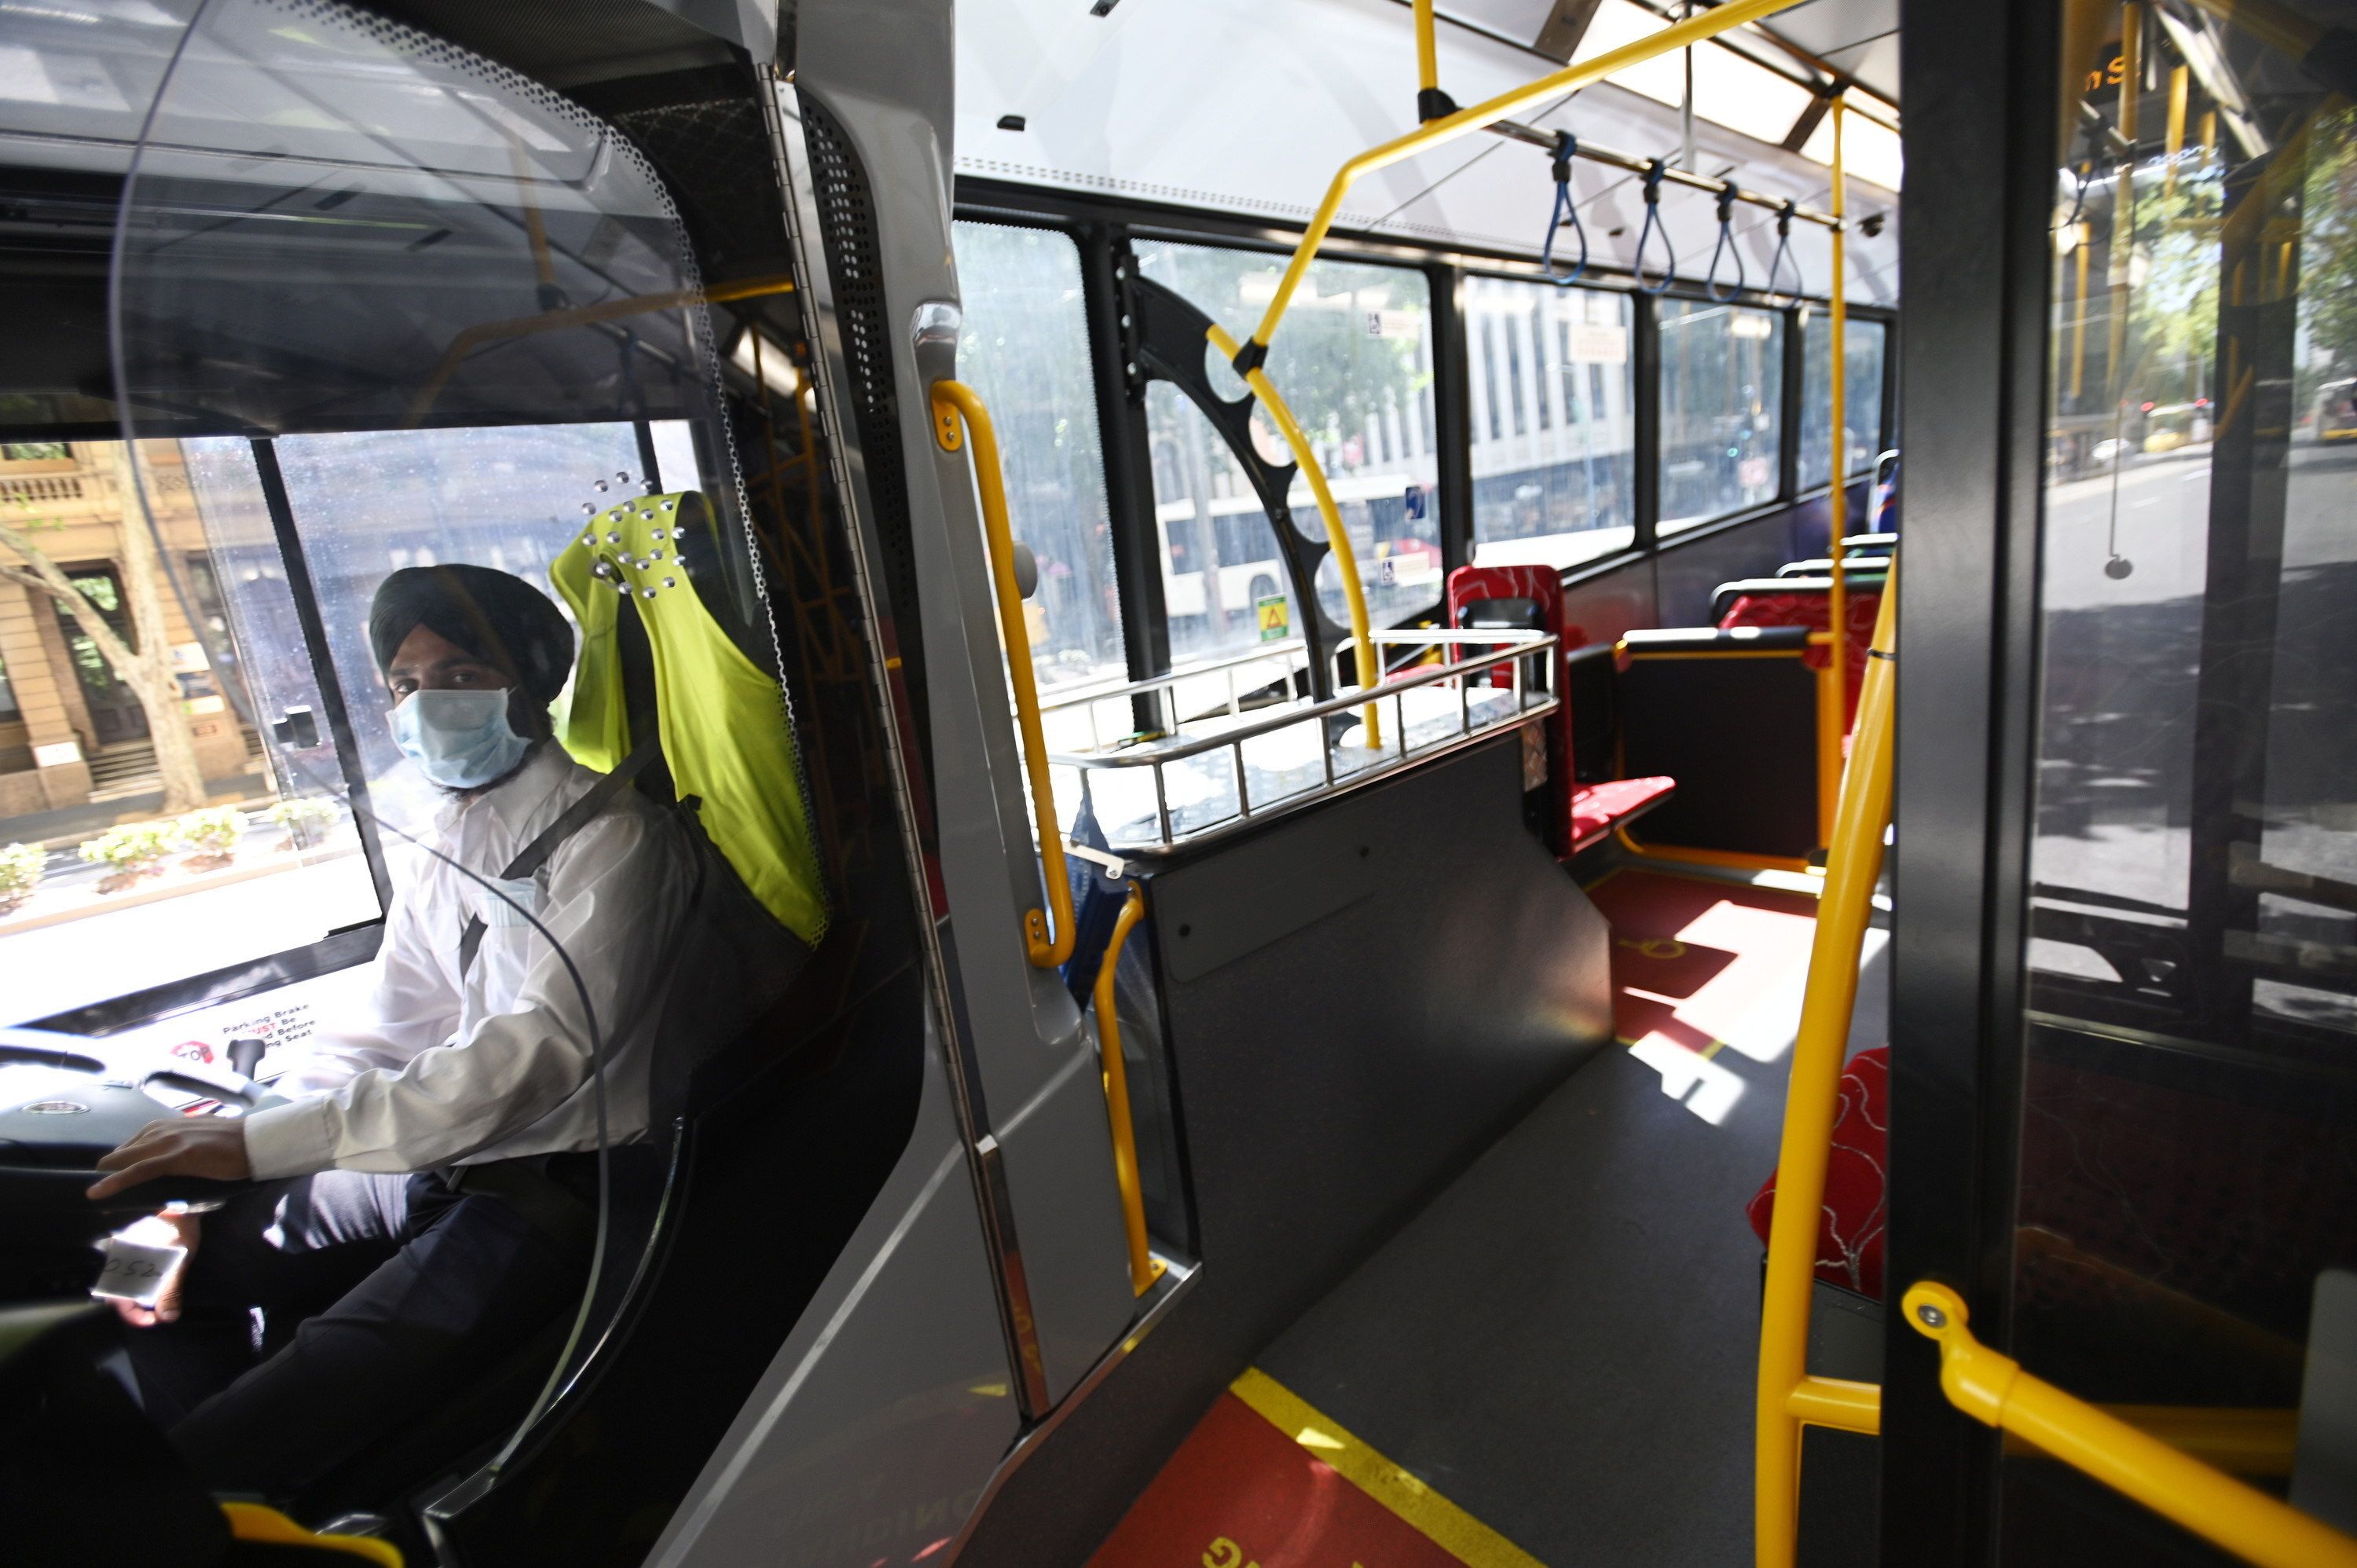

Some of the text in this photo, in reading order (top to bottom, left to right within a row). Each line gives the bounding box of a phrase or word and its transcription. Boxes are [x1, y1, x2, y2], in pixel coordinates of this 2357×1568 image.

[223, 1005, 309, 1034] Parkng Brake
[277, 1020, 315, 1035] Before
[285, 1030, 311, 1042] Seat
